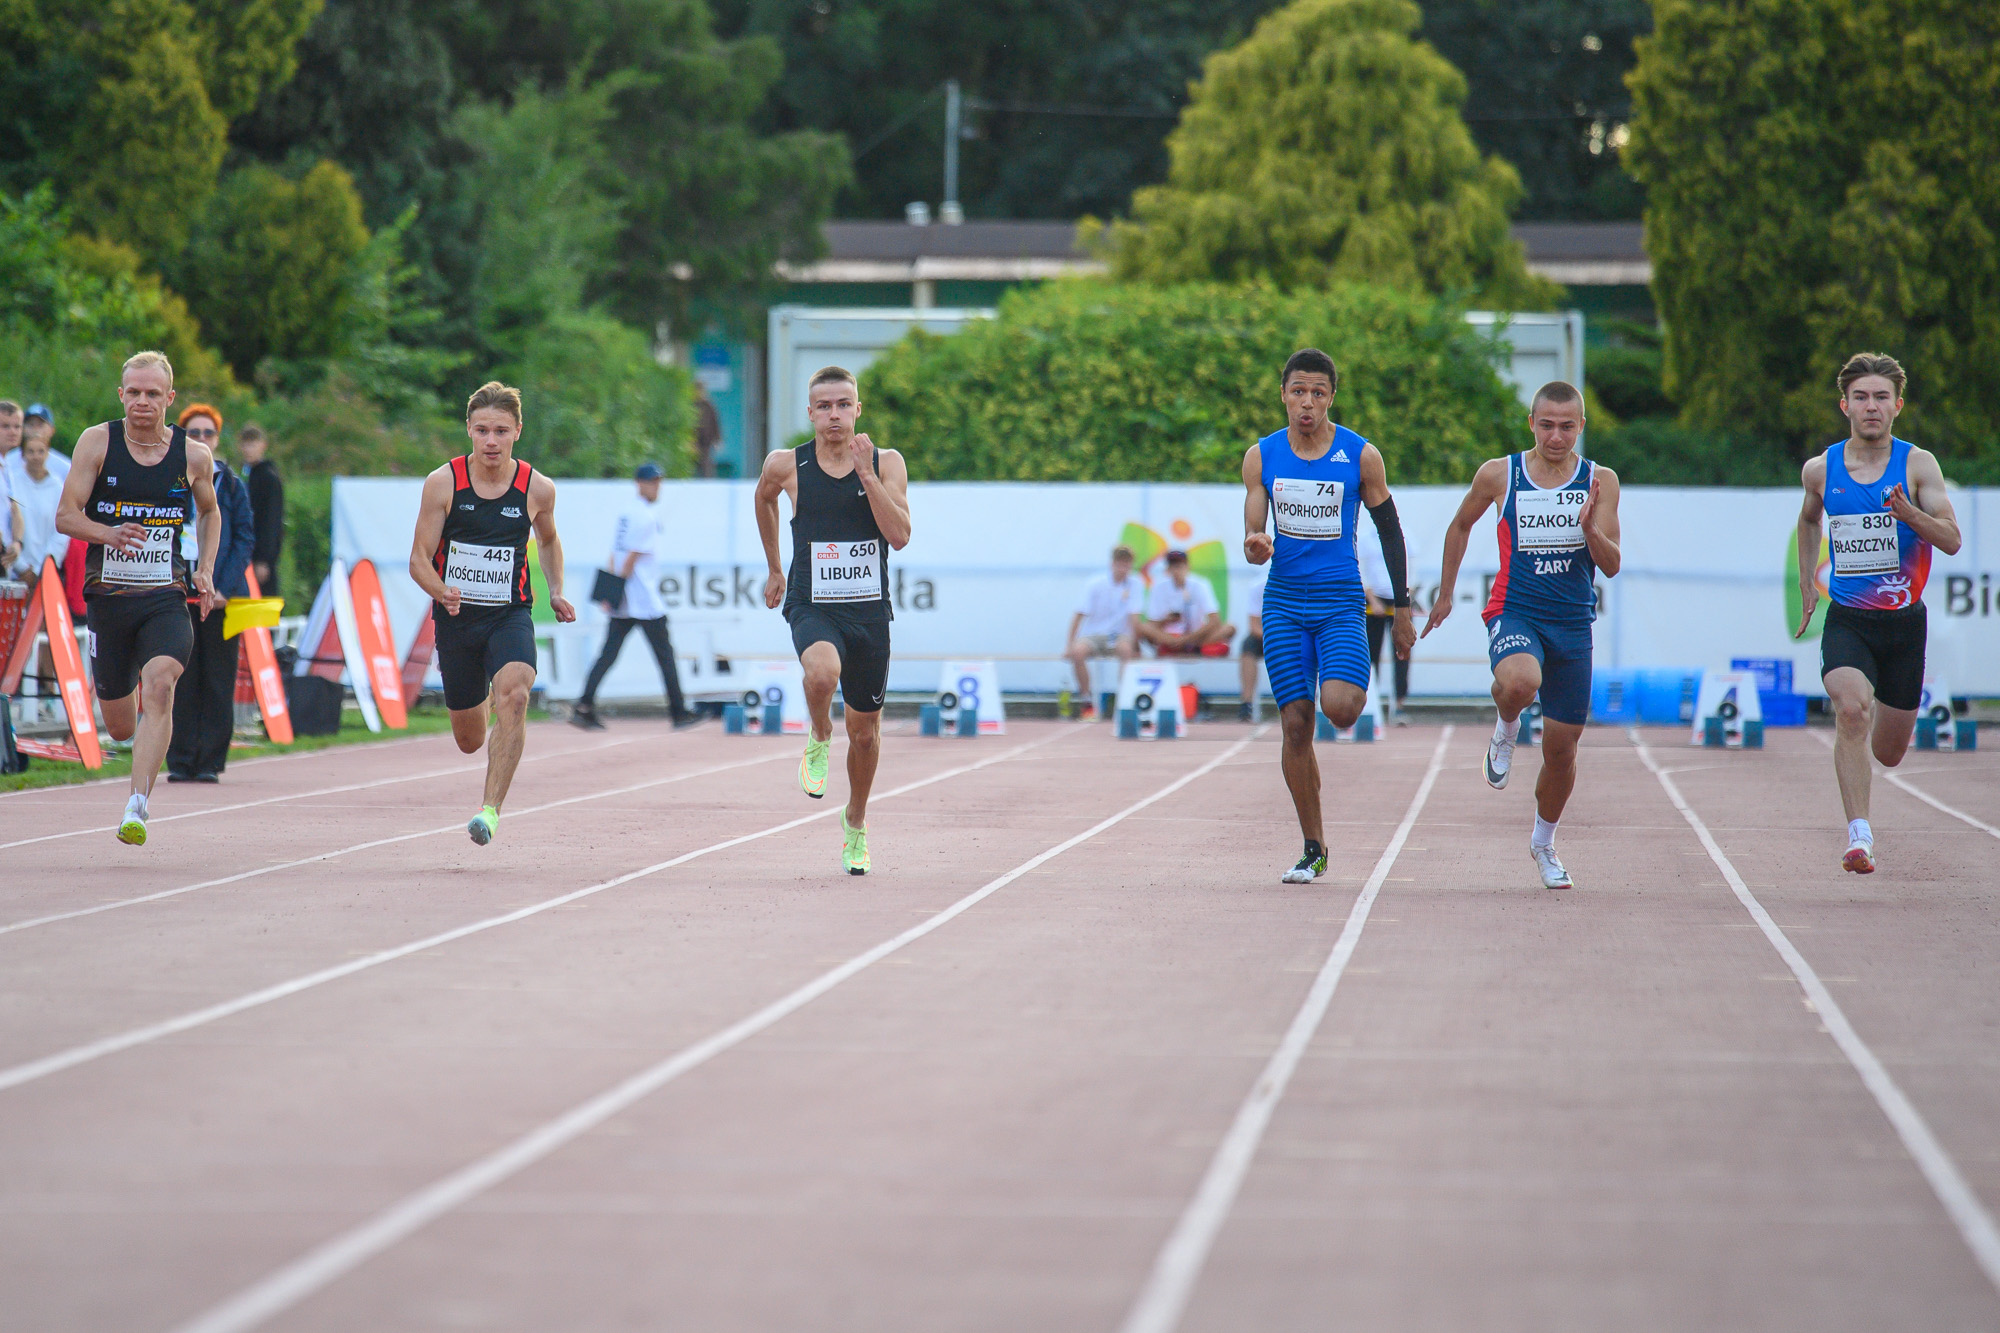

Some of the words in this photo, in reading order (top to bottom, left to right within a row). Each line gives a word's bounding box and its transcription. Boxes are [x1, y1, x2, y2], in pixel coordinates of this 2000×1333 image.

[1316, 483, 1335, 496] 74
[1556, 492, 1584, 505] 198
[1276, 502, 1339, 518] KPORHOTOR
[1862, 515, 1892, 529] 830
[146, 529, 170, 541] 764
[850, 542, 876, 557] 650
[1834, 537, 1896, 553] BŁASZCZYK
[106, 548, 169, 563] KRAWIEC
[483, 549, 510, 562] 443
[820, 566, 872, 580] LIBURA
[1534, 558, 1572, 575] ŻARY
[448, 565, 510, 584] KOŚCIELNIAK
[1945, 573, 2000, 617] Bi
